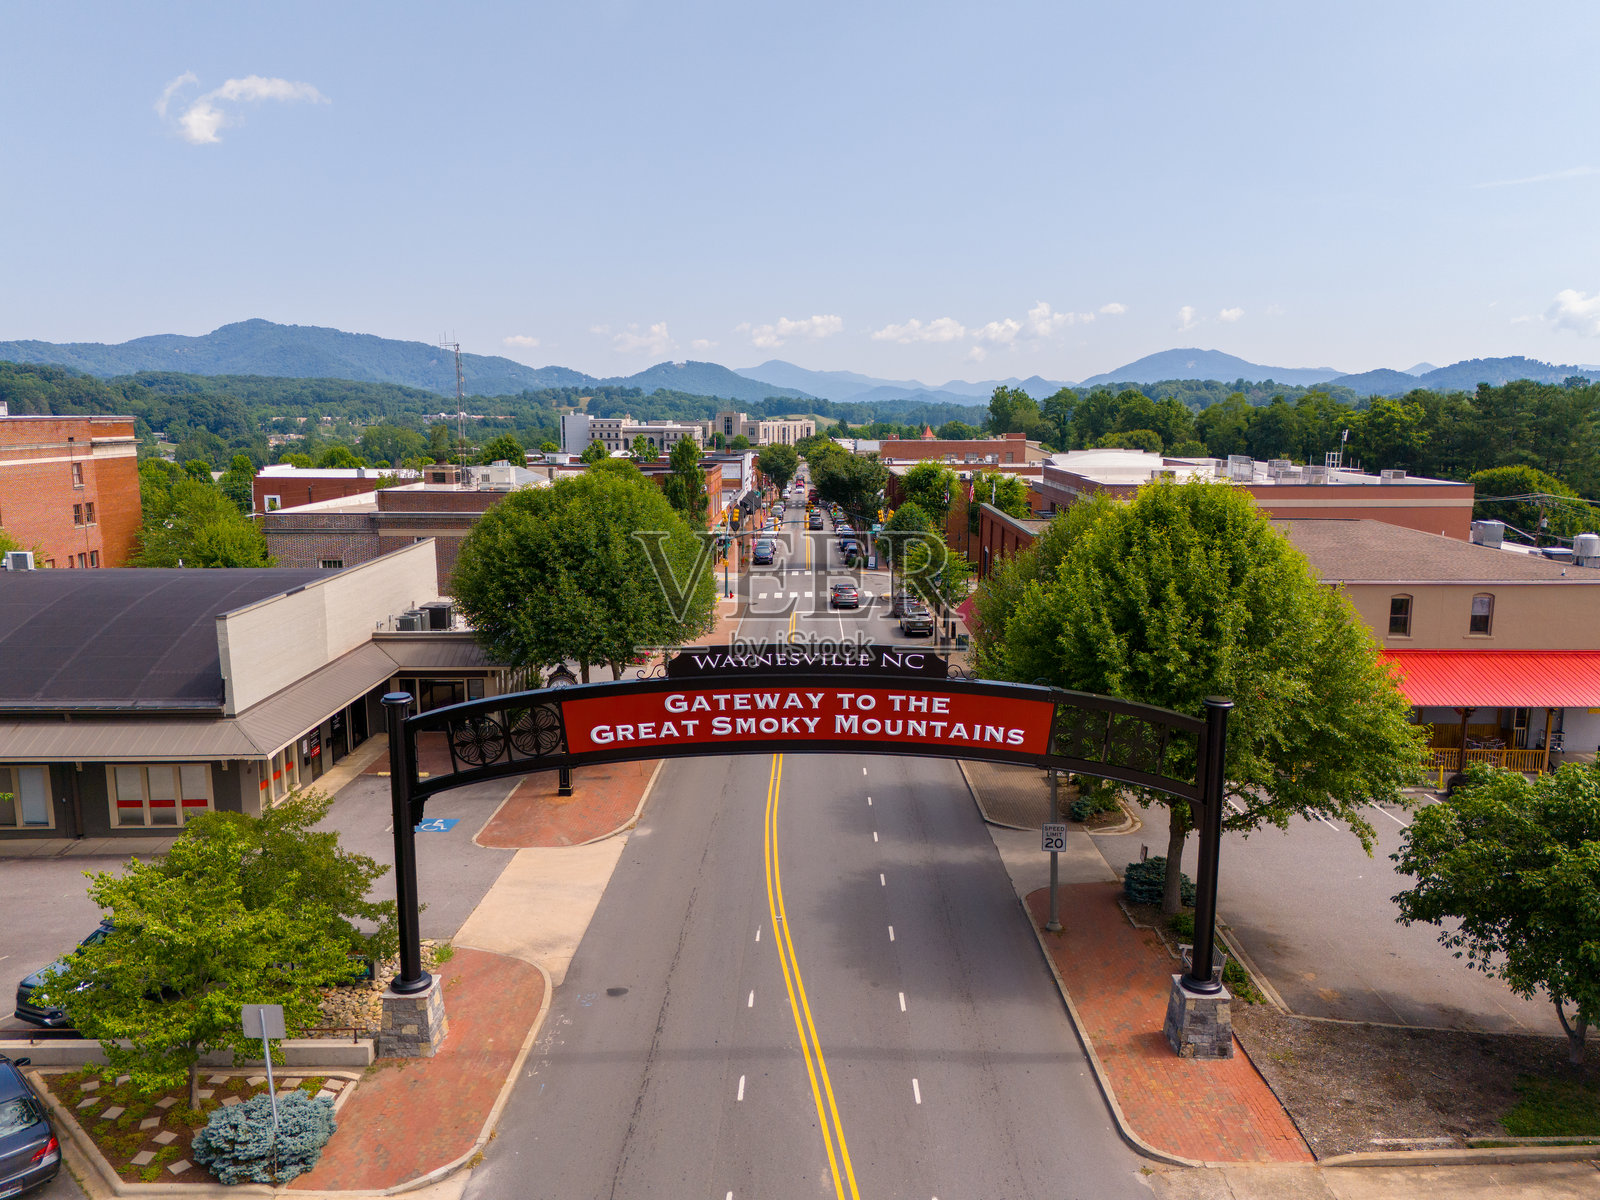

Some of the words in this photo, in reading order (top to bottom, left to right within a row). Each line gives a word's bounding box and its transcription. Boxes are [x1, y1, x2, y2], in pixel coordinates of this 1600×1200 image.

[692, 653, 870, 669] WAYNESVILLE
[880, 653, 925, 669] NC
[664, 692, 825, 713] GATEWAY
[837, 693, 876, 711] TO
[888, 694, 950, 714] THE
[590, 721, 699, 744] GREAT
[711, 716, 821, 736] SMOKY
[834, 714, 1025, 745] MOUNTAINS
[1045, 838, 1063, 848] 20
